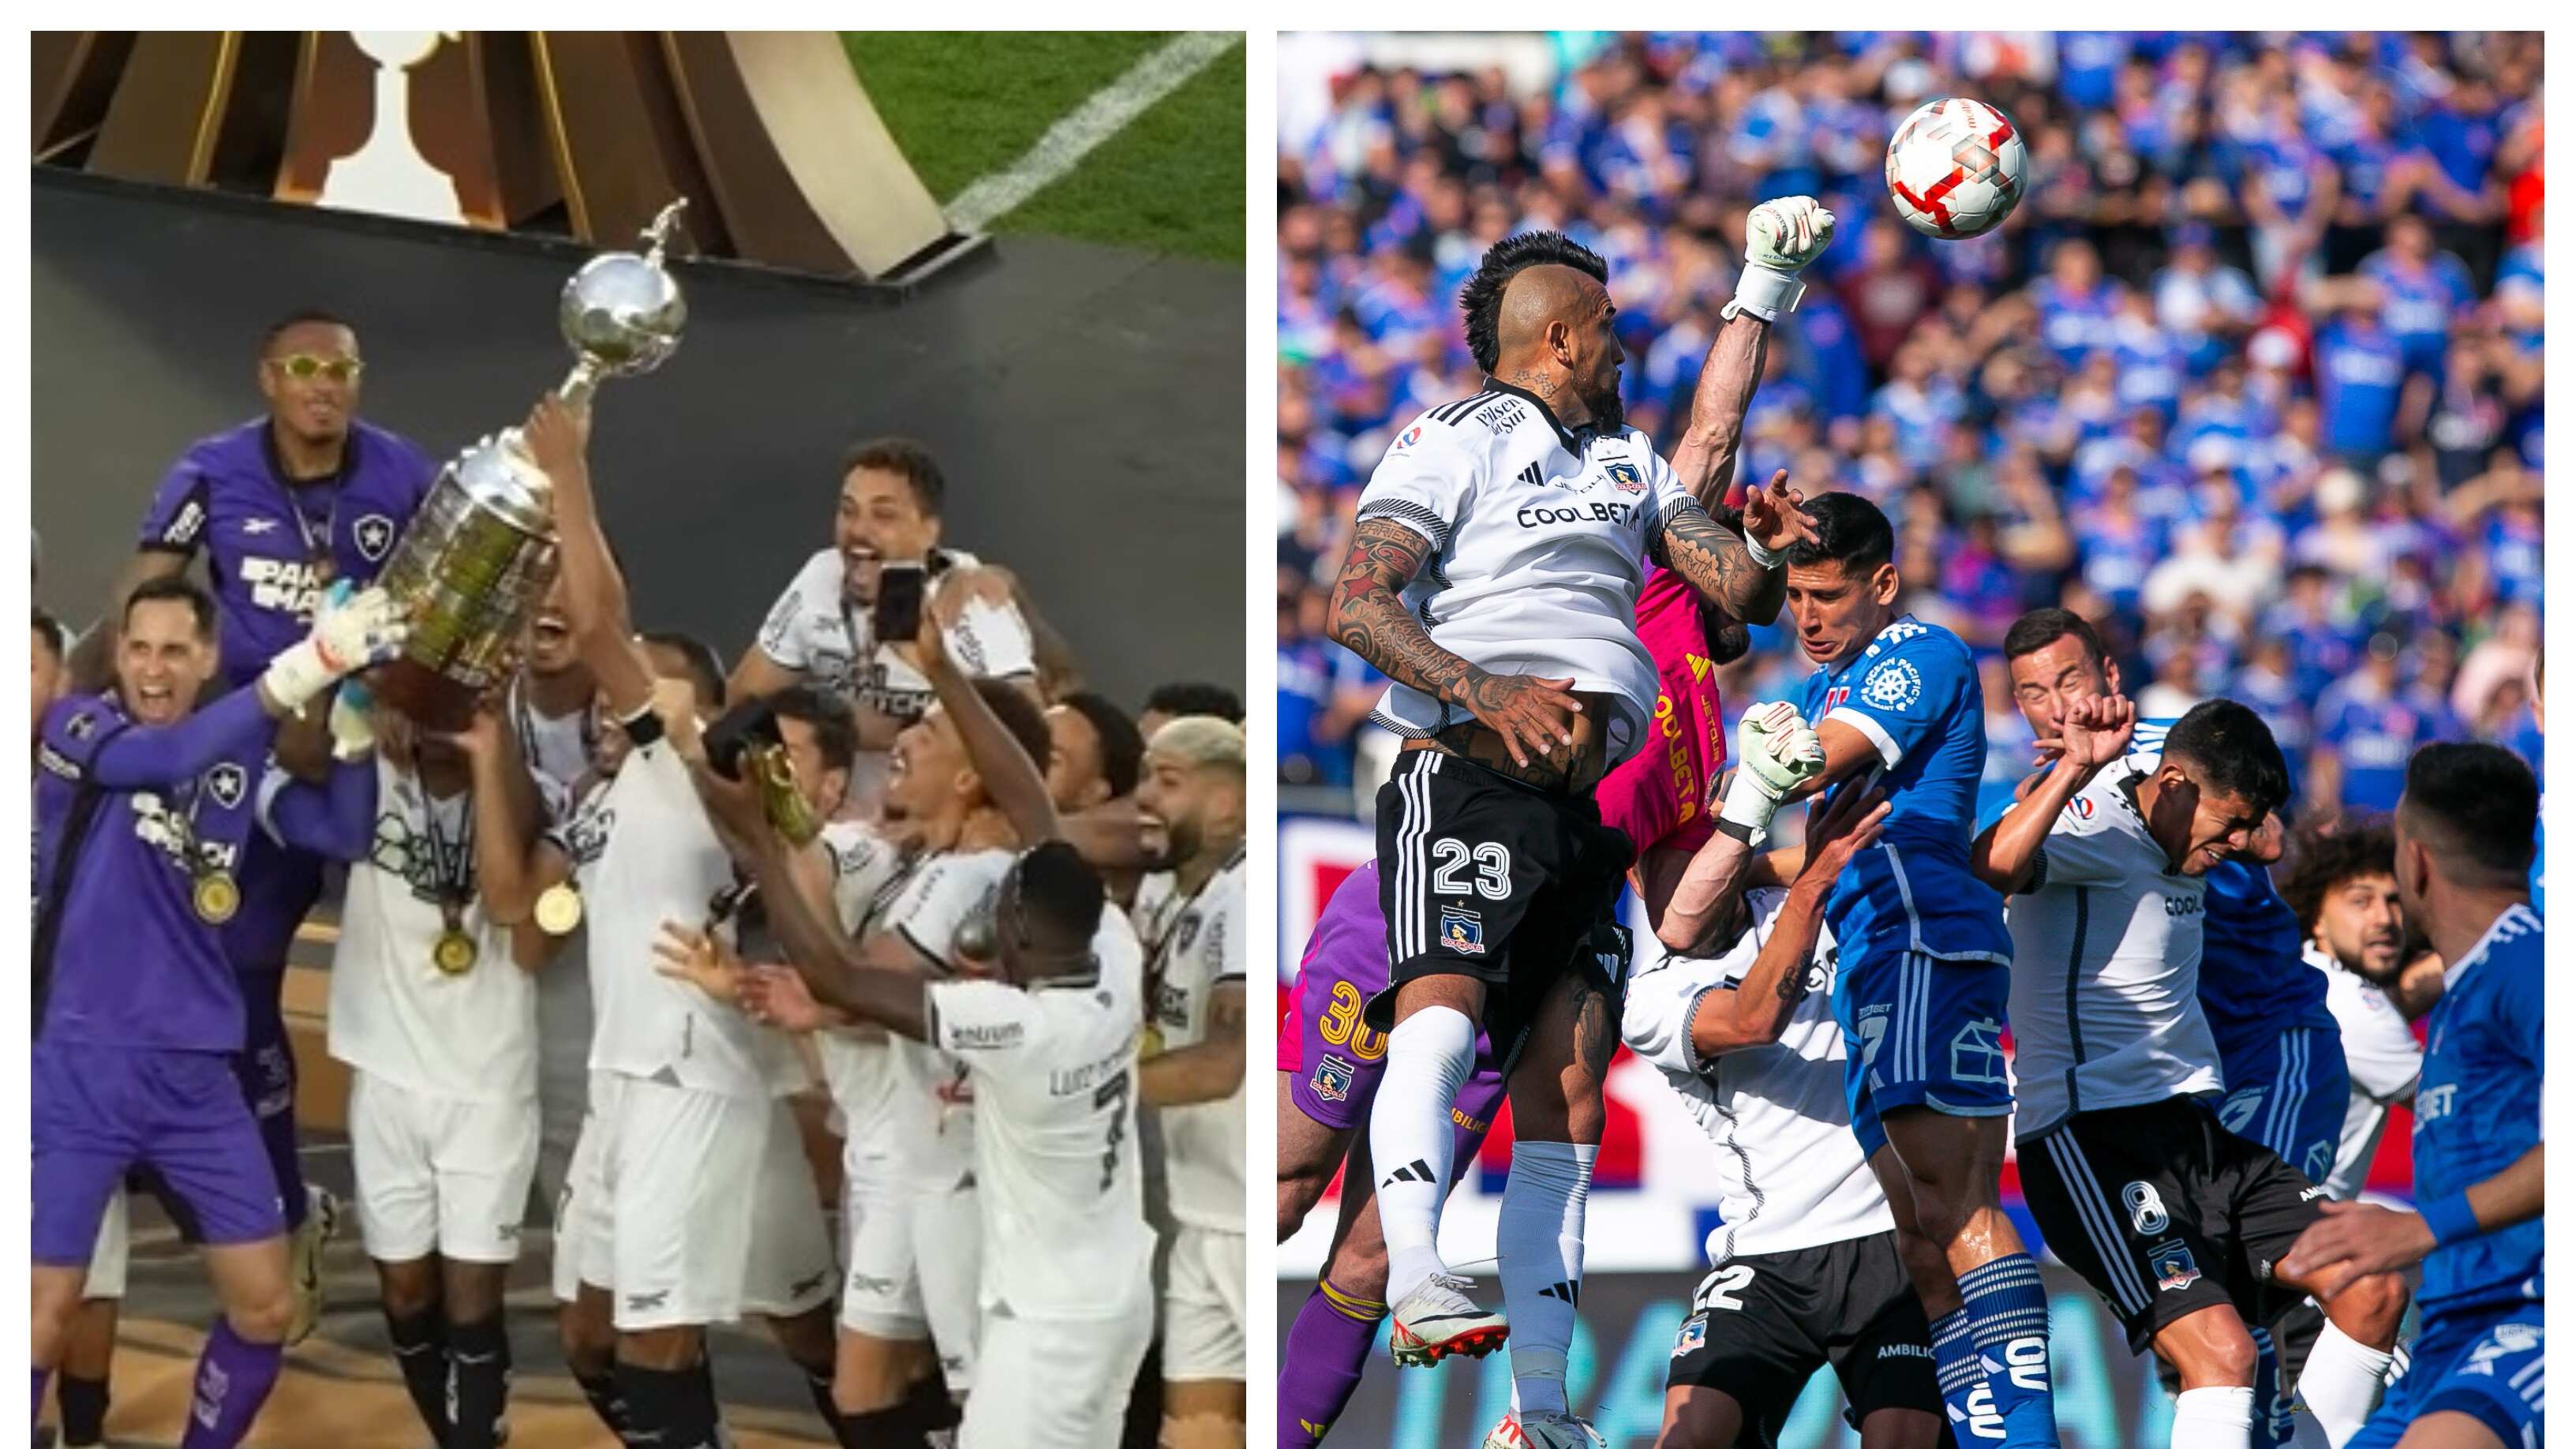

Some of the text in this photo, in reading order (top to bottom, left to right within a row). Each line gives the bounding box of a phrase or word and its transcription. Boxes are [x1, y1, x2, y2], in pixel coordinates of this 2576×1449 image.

[1475, 399, 1521, 427] Pilsen
[1500, 406, 1527, 434] Sur
[1517, 502, 1631, 529] COOLBET
[1865, 657, 1922, 706] OCEAN PACIFIC'S
[1654, 695, 1694, 799] OOLBET
[1701, 695, 1720, 762] JETOUR
[1432, 837, 1512, 900] 23
[1443, 938, 1484, 953] COLO-COLO
[1312, 1082, 1344, 1100] COLO-COLO
[2121, 1181, 2169, 1235] 8
